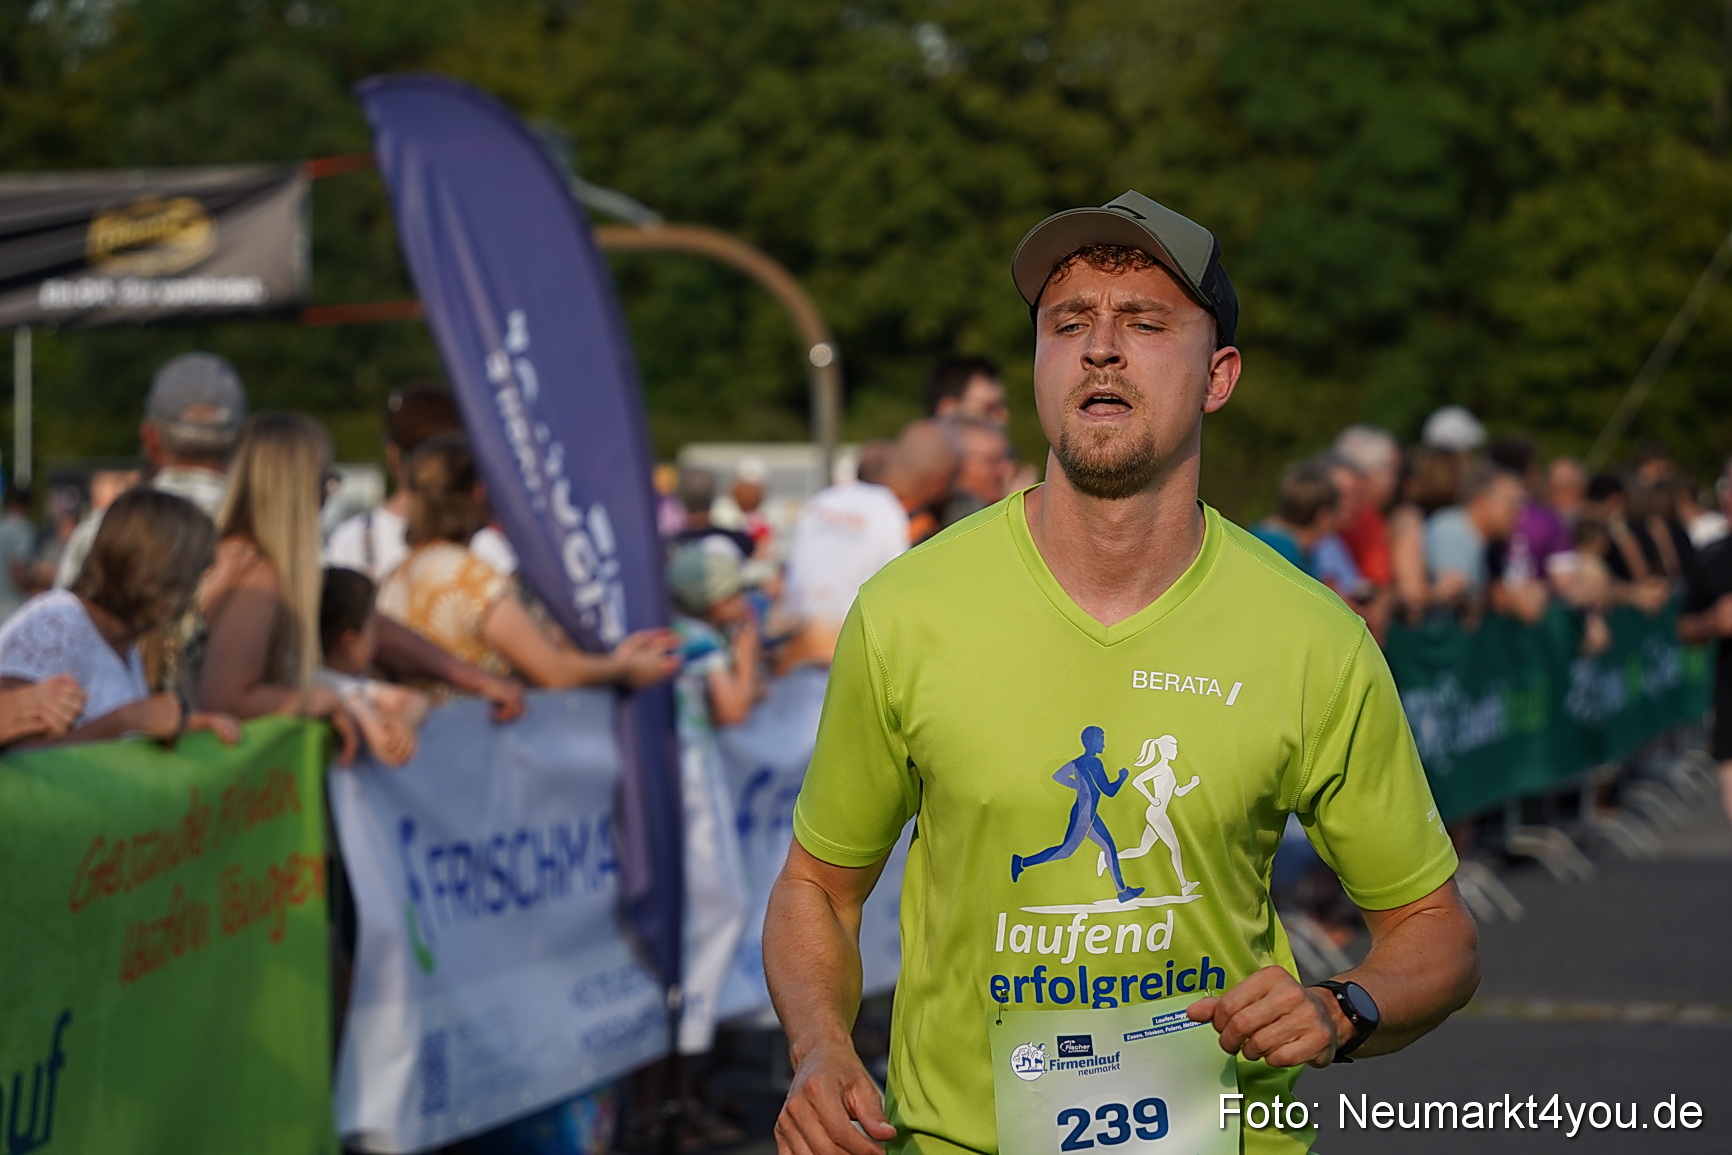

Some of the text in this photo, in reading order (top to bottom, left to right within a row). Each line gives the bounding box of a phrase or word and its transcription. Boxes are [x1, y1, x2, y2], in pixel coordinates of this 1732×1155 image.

[1132, 670, 1223, 699] BERATA
[994, 909, 1174, 965] laufend
[990, 956, 1225, 1009] erfolgreich
[1049, 1051, 1121, 1071] Firmenlauf
[1065, 1043, 1091, 1051] Fischer
[0, 1008, 71, 1155] uf
[1078, 1063, 1121, 1076] neumarkt
[1057, 1097, 1169, 1152] 239
